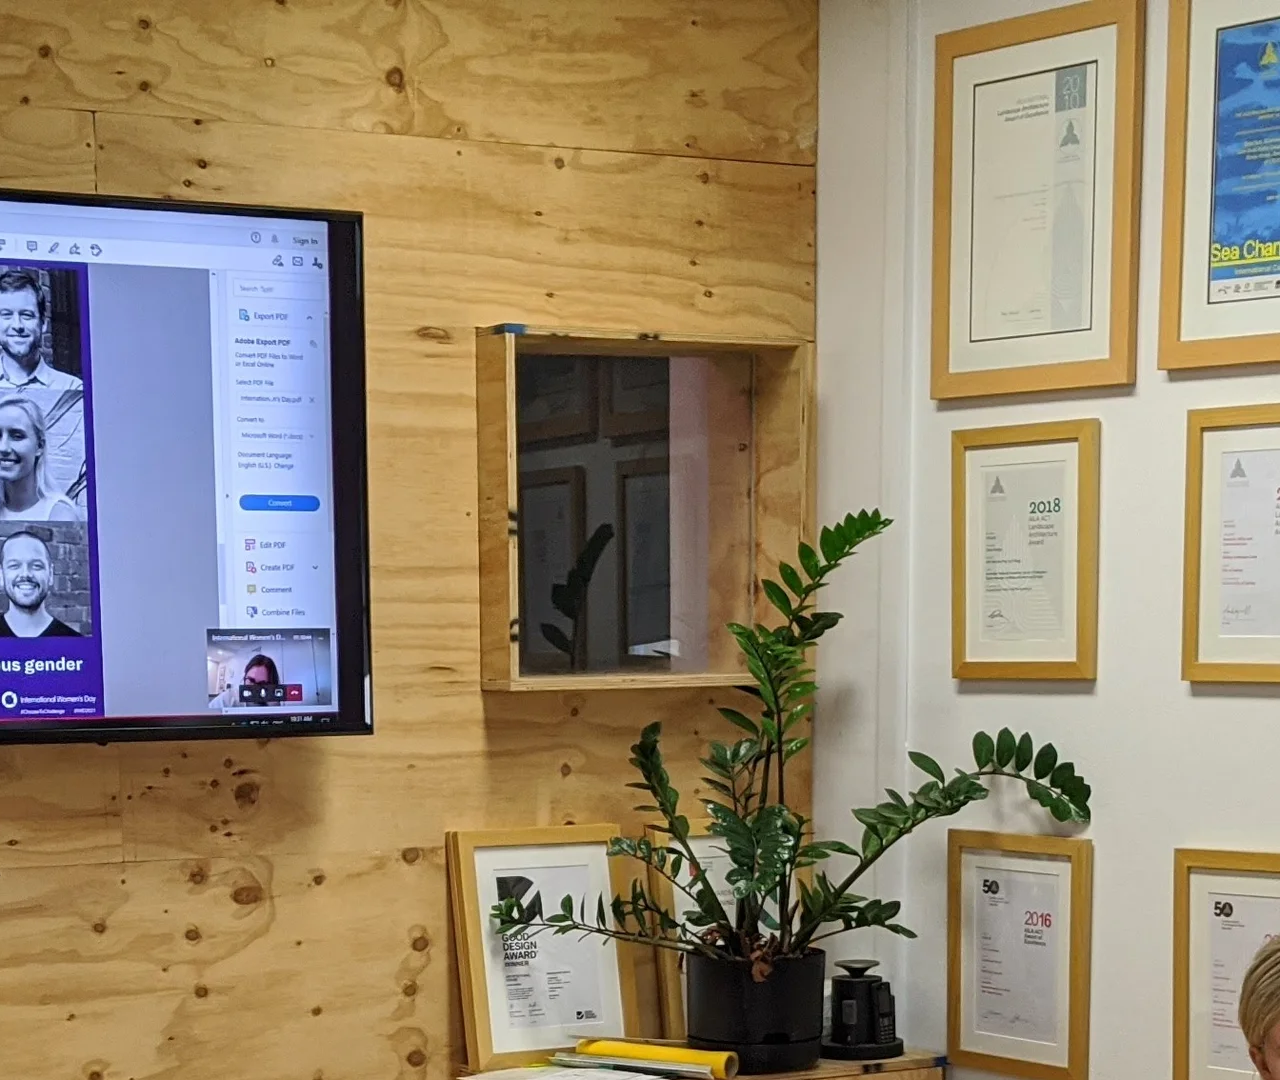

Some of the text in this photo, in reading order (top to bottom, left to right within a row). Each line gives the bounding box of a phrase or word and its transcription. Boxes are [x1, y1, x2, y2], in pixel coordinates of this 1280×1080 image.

[293, 237, 309, 246] Sign
[1211, 243, 1240, 261] Sea
[254, 312, 274, 320] Export
[256, 338, 276, 346] Export
[1029, 498, 1061, 514] 2018
[1029, 523, 1055, 531] Landscape
[24, 657, 84, 676] gender
[84, 695, 96, 703] Day
[982, 879, 999, 894] 50
[1214, 901, 1233, 917] 50
[1024, 911, 1052, 928] 2016
[502, 933, 529, 942] GOOD
[503, 941, 537, 951] DESIGN
[504, 951, 537, 960] AWARD
